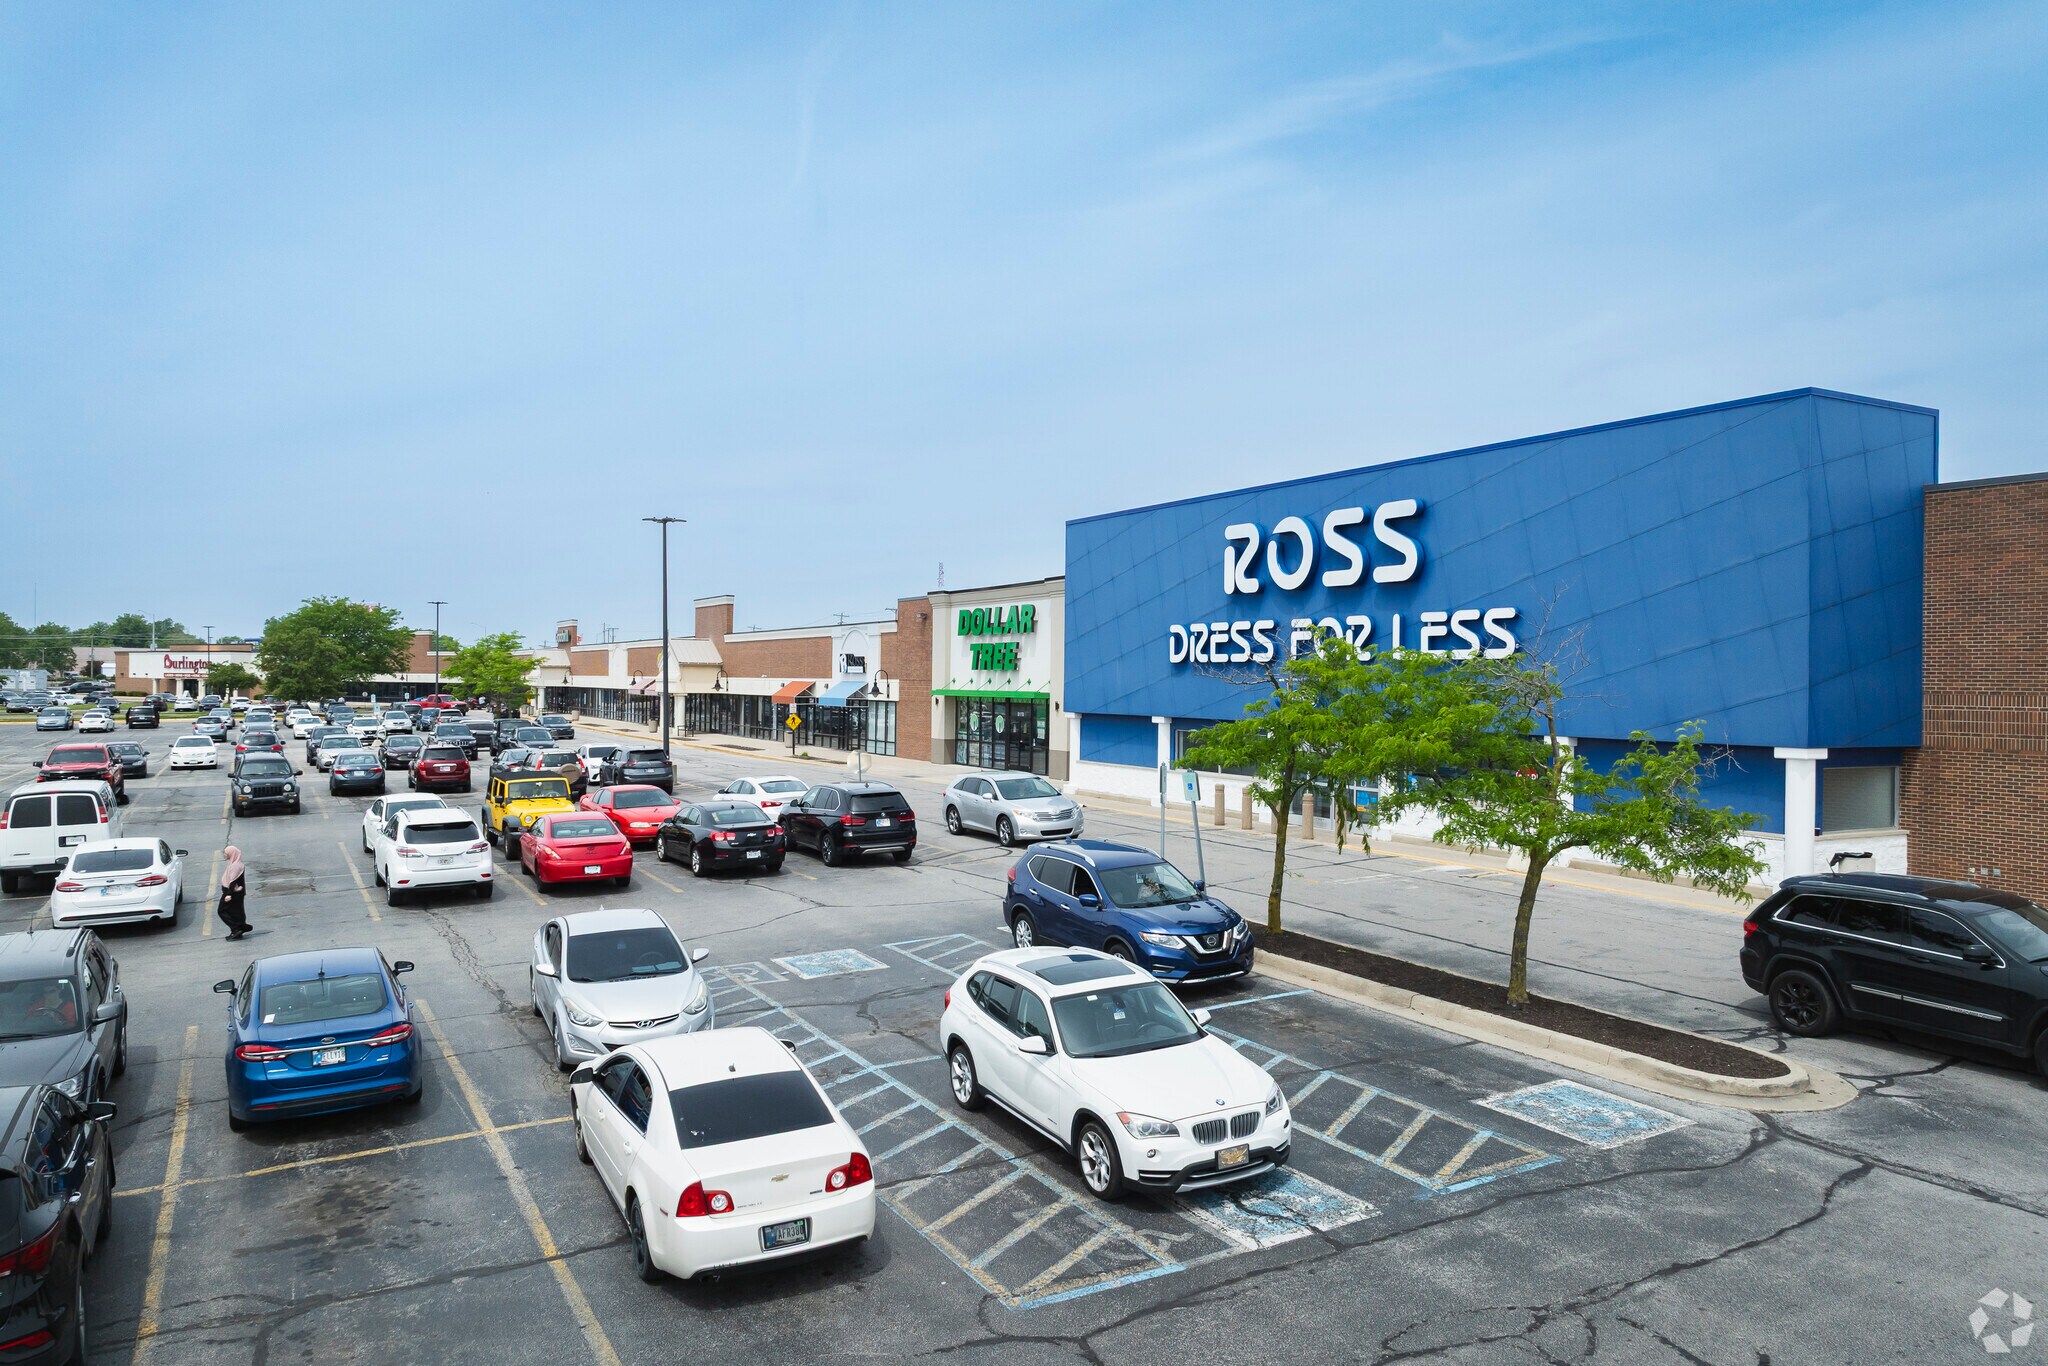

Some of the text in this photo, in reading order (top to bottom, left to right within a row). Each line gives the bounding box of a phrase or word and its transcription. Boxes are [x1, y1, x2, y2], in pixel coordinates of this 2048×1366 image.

[1224, 499, 1418, 594] ROSS
[958, 604, 1035, 636] DOLLAR
[1169, 620, 1275, 663] DRESS
[1291, 615, 1372, 661] FOR
[164, 654, 212, 674] Burlingto
[970, 642, 1018, 671] TREE
